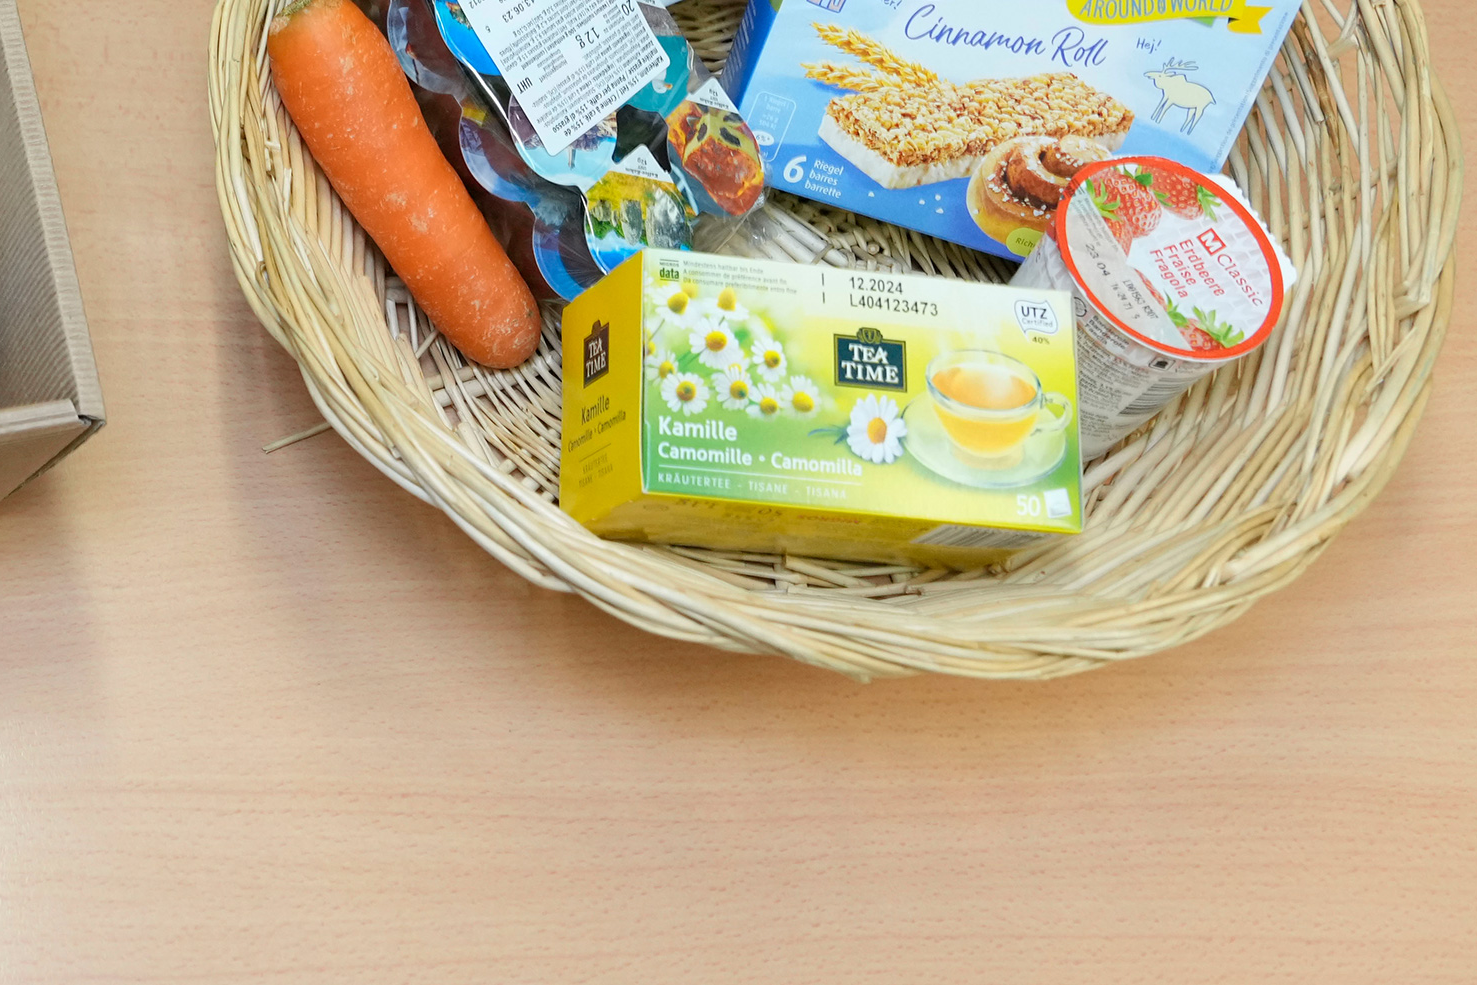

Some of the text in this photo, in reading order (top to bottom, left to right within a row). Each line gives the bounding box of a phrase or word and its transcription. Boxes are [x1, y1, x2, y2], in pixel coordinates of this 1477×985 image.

[572, 25, 601, 50] 12 g
[903, 3, 1109, 69] Cinnamon Roll
[1135, 36, 1162, 55] Hej!
[513, 75, 534, 95] UHT
[781, 155, 806, 183] 6
[808, 168, 839, 187] barres
[812, 156, 845, 177] Riegel
[804, 180, 843, 200] barrette
[659, 268, 680, 280] data
[1148, 248, 1187, 301] Fragola
[1161, 244, 1197, 289] Fraise
[1177, 237, 1226, 298] Erdbeere
[847, 277, 904, 296] 12.2024
[1216, 253, 1264, 309] Classic
[848, 294, 939, 317] L404123473
[1020, 305, 1048, 320] UTZ
[1020, 316, 1055, 330] Certified
[588, 339, 604, 363] TEA
[848, 342, 891, 364] TEA
[584, 352, 609, 380] TIME
[840, 359, 900, 385] TIME
[579, 394, 611, 426] Kamille
[657, 415, 738, 442] Kamille
[657, 442, 863, 479] Camomille Camomilla
[657, 471, 848, 500] KRÄUTERTEE TISANE TISANA
[1016, 495, 1042, 517] 50
